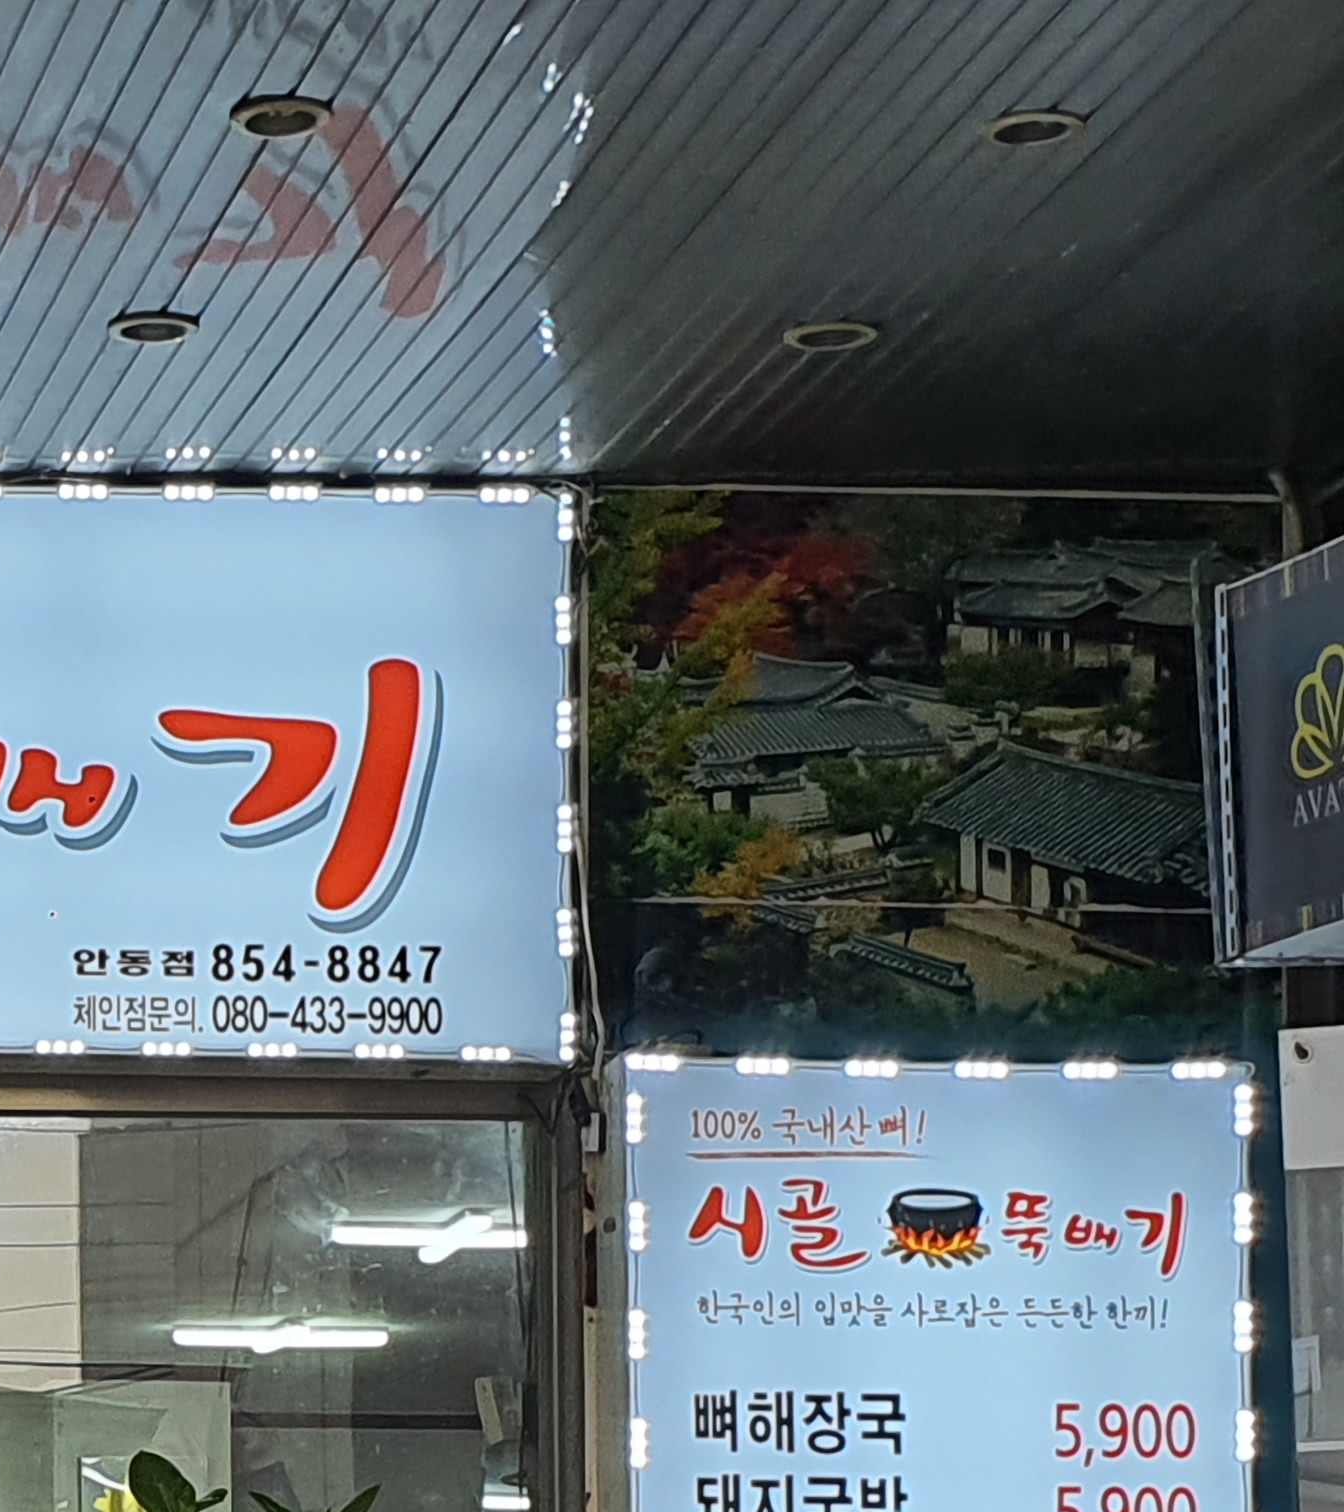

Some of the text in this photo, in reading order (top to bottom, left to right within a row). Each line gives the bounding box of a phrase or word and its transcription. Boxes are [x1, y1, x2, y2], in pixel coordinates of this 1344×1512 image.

[72, 943, 442, 984] 안동점 854-8847
[72, 994, 443, 1036] 체인점문의. 080-433-9900
[690, 1109, 763, 1142] 100%
[771, 1106, 872, 1147] 국내산
[687, 1178, 1187, 1277] 시골 뚝배기
[696, 1289, 1169, 1331] 한국인의 입맛을 사로잡은 든든한 한끼!
[694, 1389, 1195, 1459] 뼈해장국 5,900
